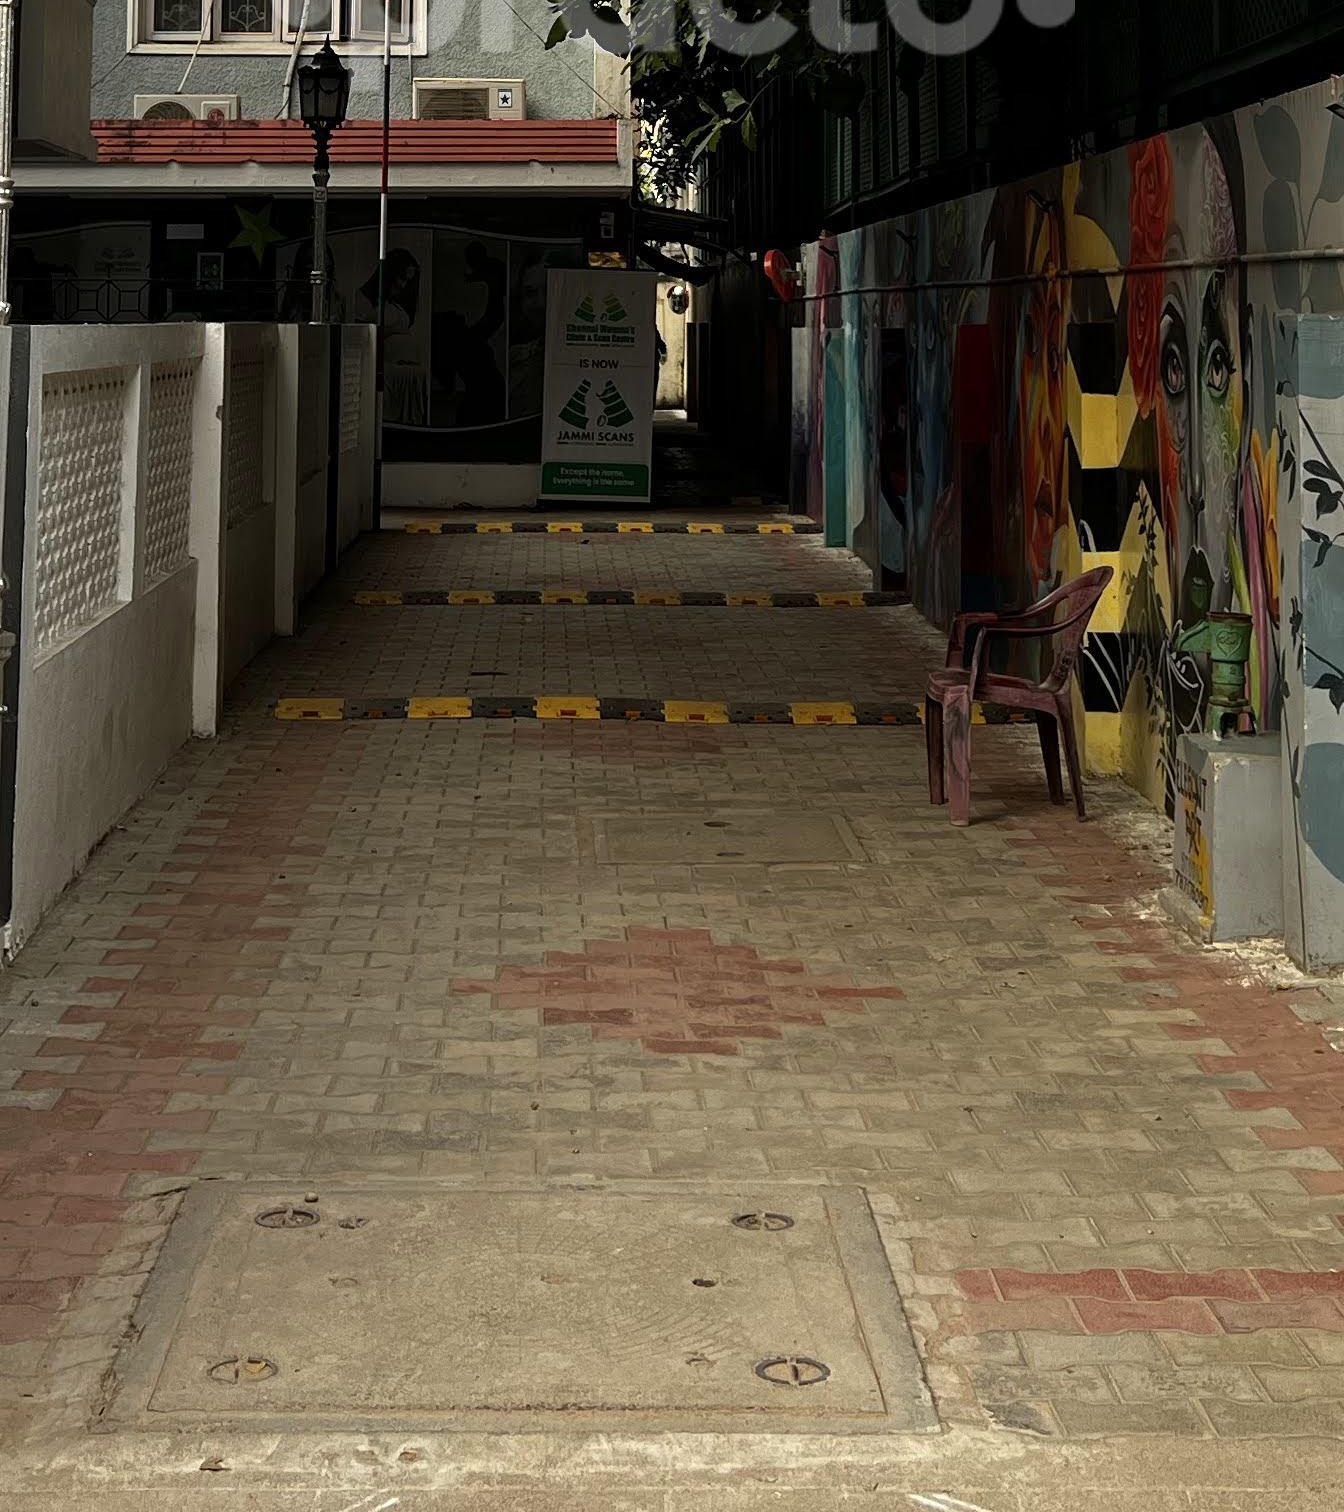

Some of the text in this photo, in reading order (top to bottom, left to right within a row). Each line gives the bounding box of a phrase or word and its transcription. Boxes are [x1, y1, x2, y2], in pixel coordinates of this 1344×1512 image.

[579, 359, 619, 369] IS NOW
[558, 431, 634, 442] JAMMI SCANS
